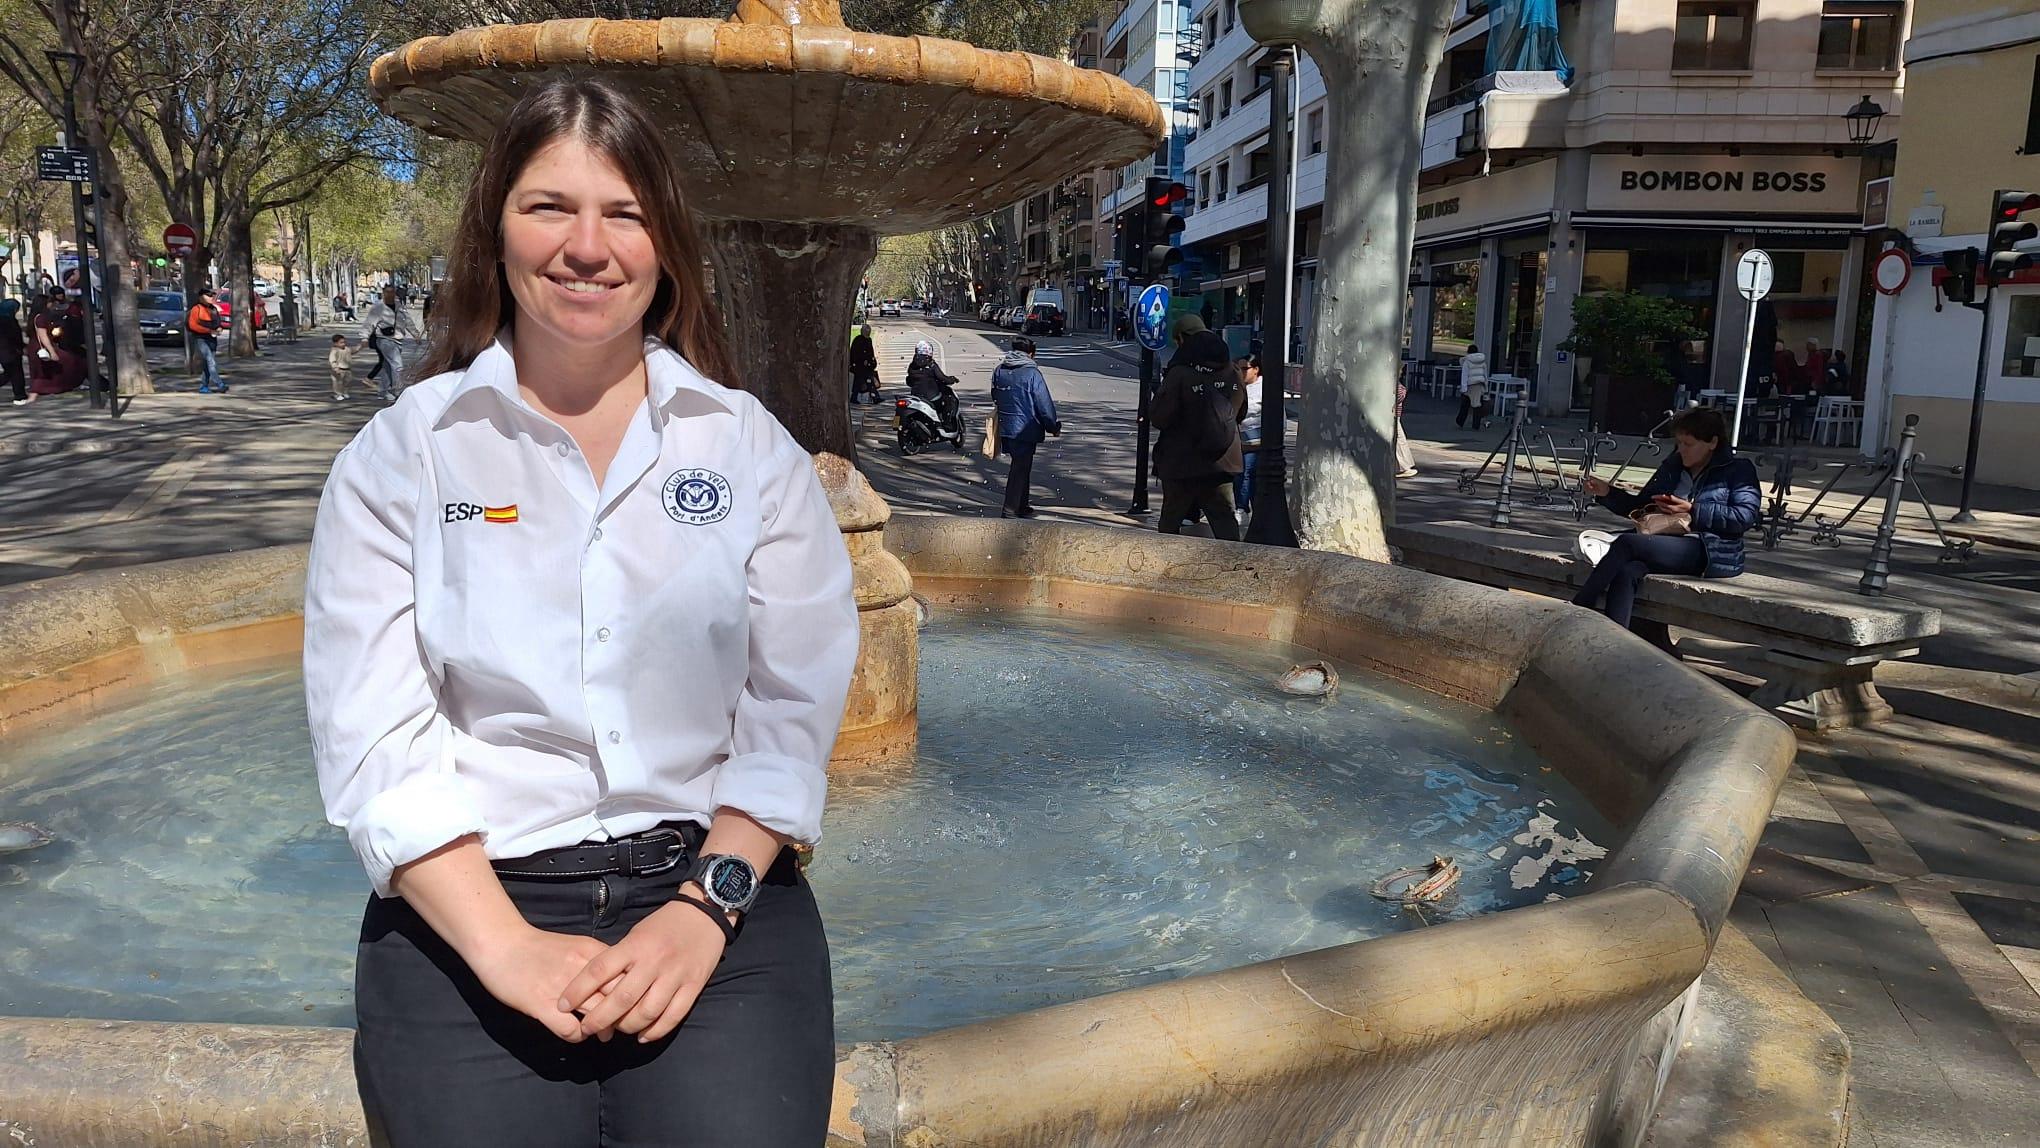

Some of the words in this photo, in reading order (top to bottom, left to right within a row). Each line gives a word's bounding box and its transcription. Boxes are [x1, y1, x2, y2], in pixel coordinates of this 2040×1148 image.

[1620, 170, 1744, 192] BOMBON
[1752, 171, 1827, 193] BOSS
[1435, 197, 1460, 217] BOSS
[666, 472, 686, 493] Club
[689, 471, 704, 479] de
[708, 473, 726, 492] Vela
[445, 502, 484, 523] ESP
[669, 505, 686, 520] Port
[690, 505, 728, 523] d'Andratx
